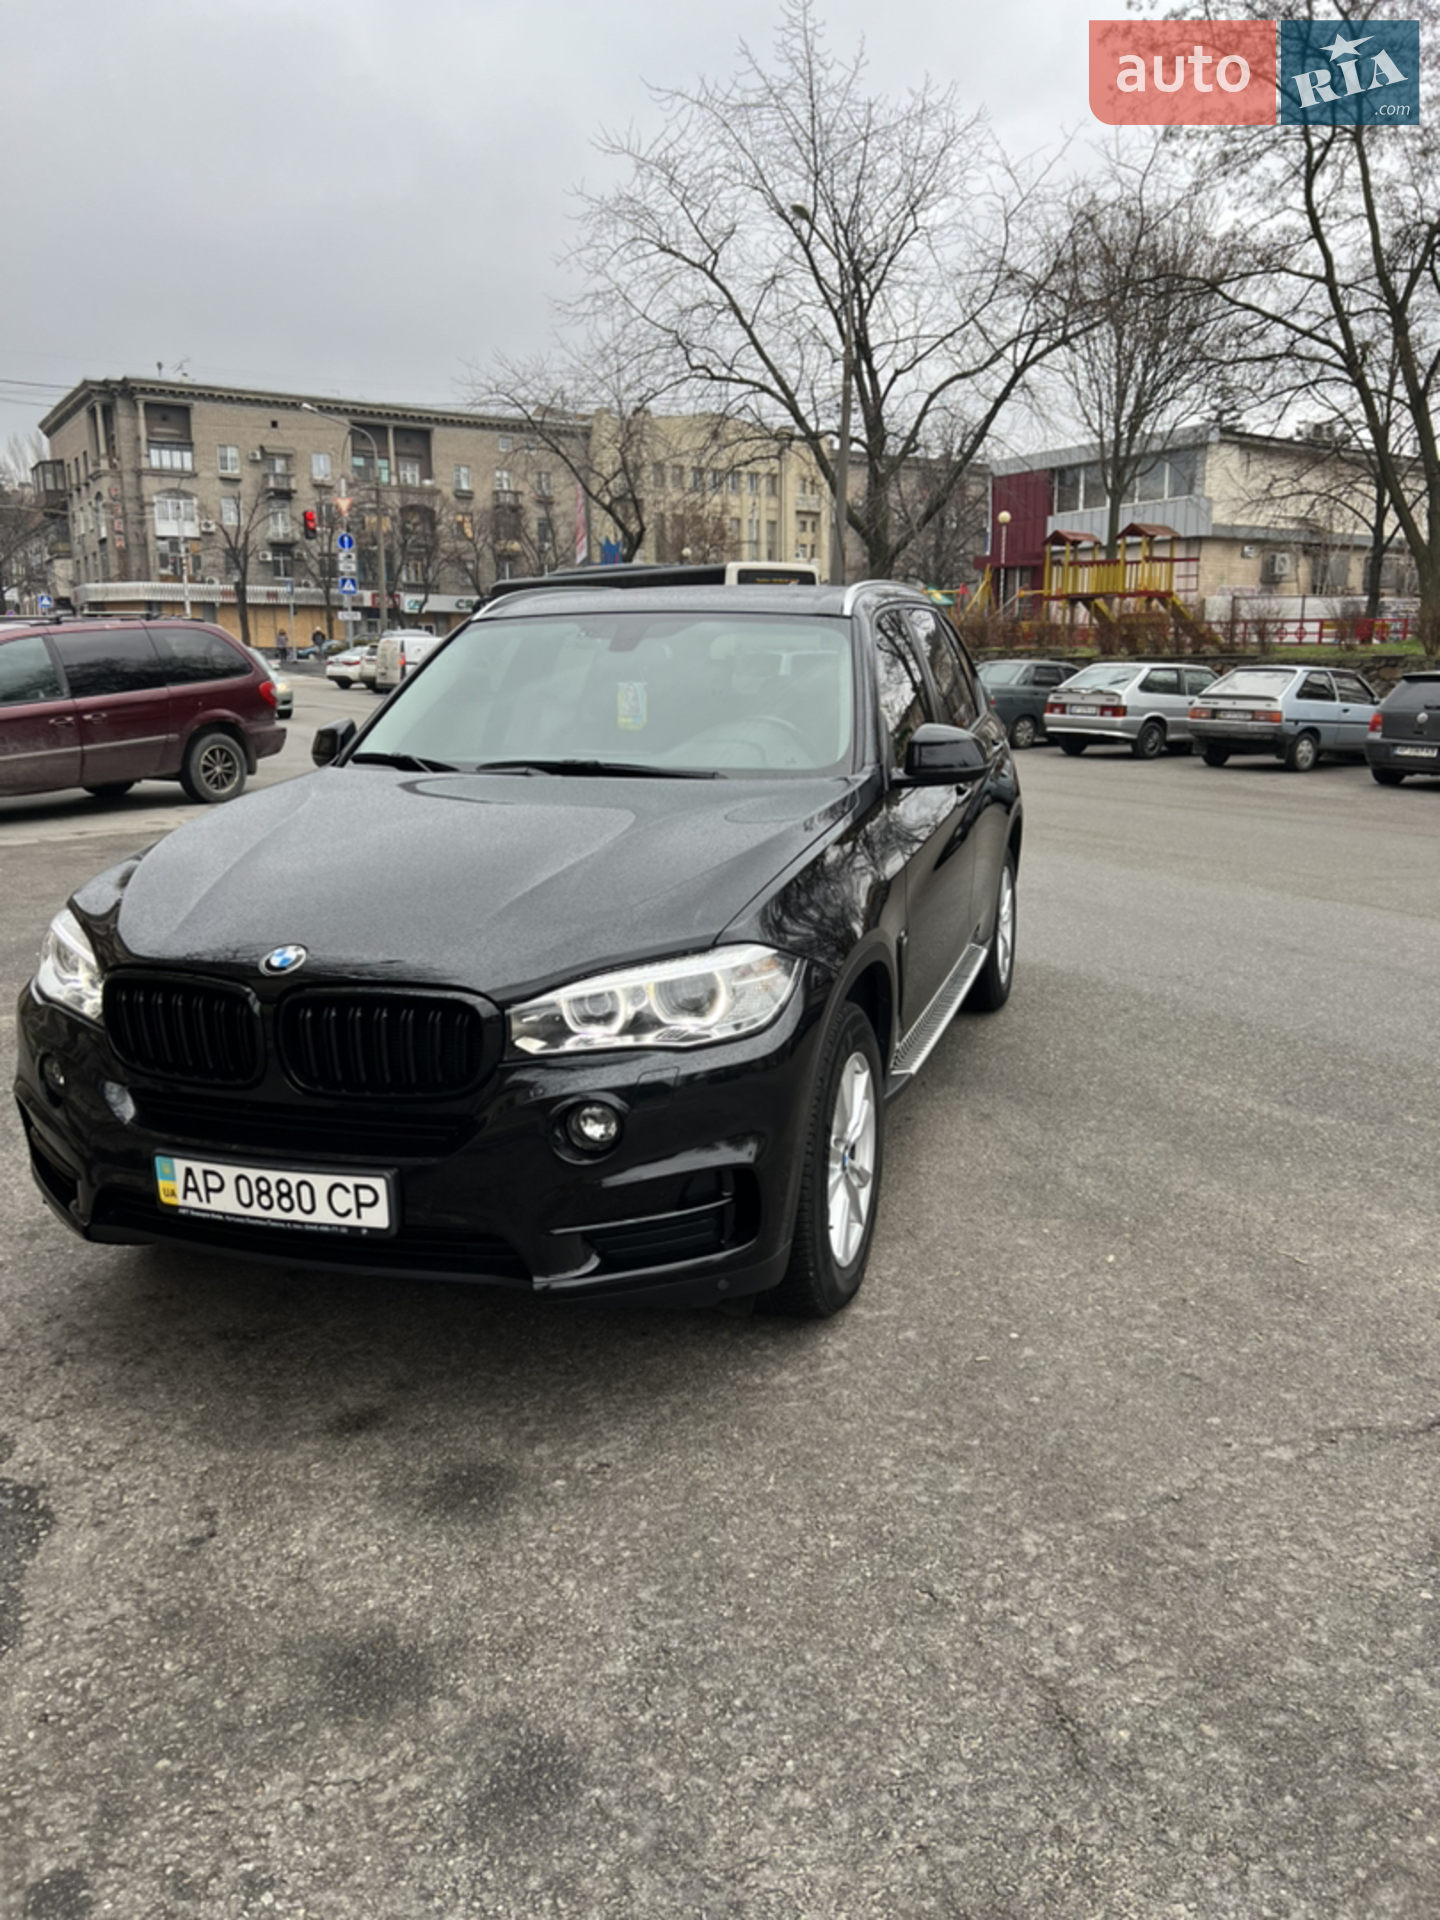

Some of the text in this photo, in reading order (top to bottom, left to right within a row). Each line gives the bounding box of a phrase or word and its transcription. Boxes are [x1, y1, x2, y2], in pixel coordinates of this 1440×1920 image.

[163, 1188, 177, 1198] UA
[182, 1166, 380, 1219] AP 0880 CP
